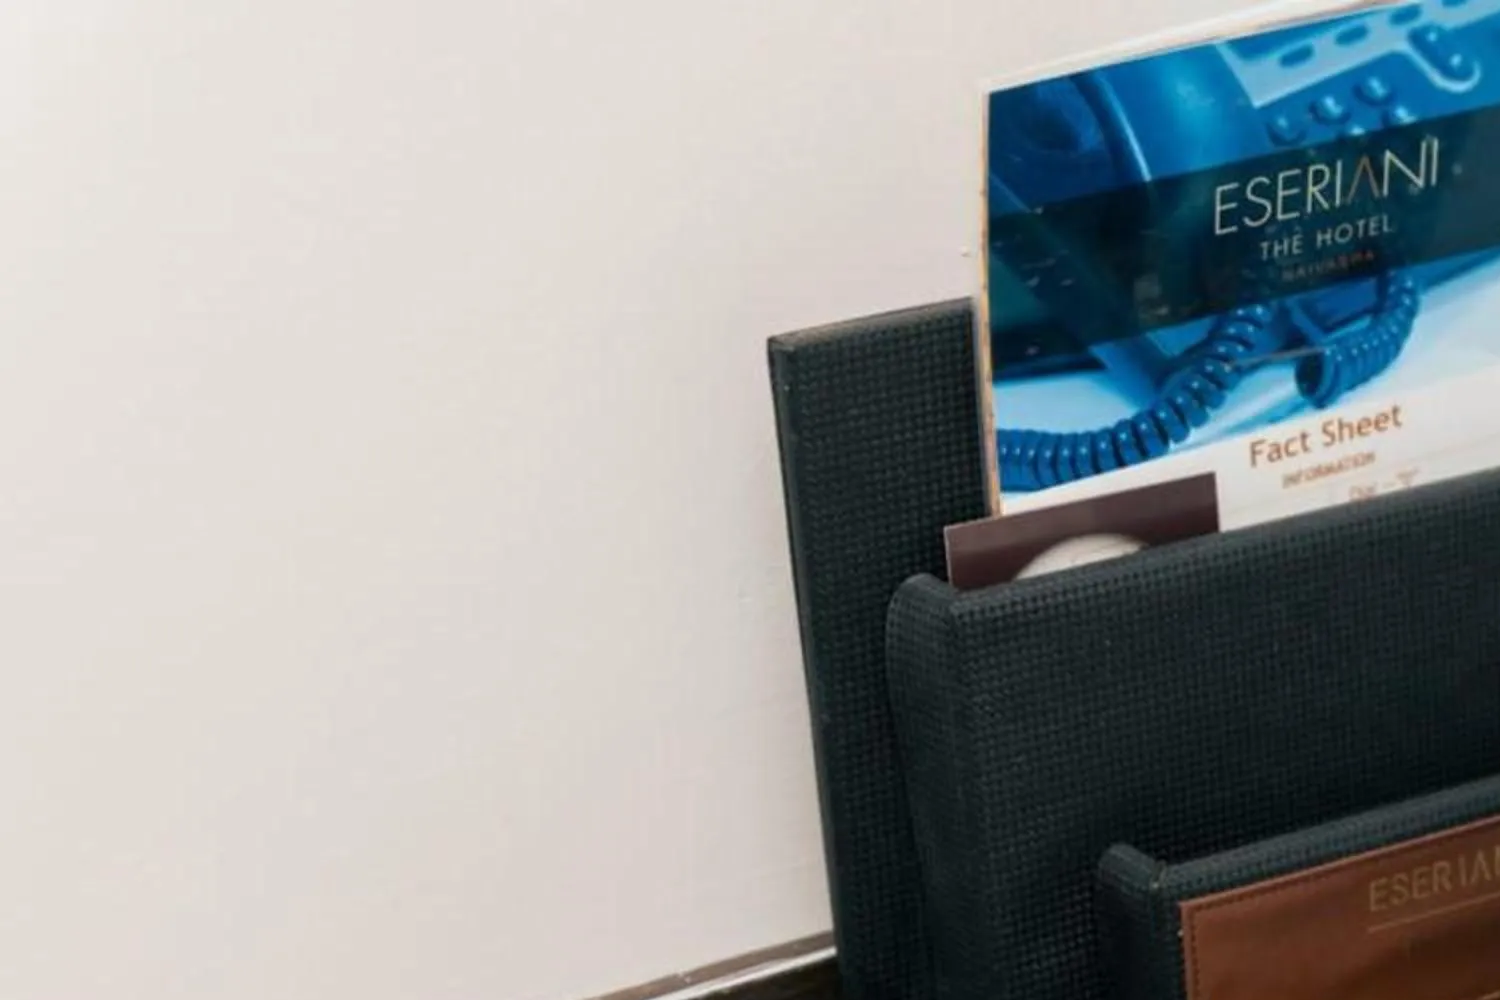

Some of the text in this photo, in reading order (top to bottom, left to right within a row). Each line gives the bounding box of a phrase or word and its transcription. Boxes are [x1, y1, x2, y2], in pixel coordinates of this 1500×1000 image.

[1214, 136, 1439, 236] ESERIANI
[1260, 214, 1393, 261] THE HOTEL
[1250, 405, 1403, 468] Fact Sheet
[1282, 451, 1376, 489] INFORMATION
